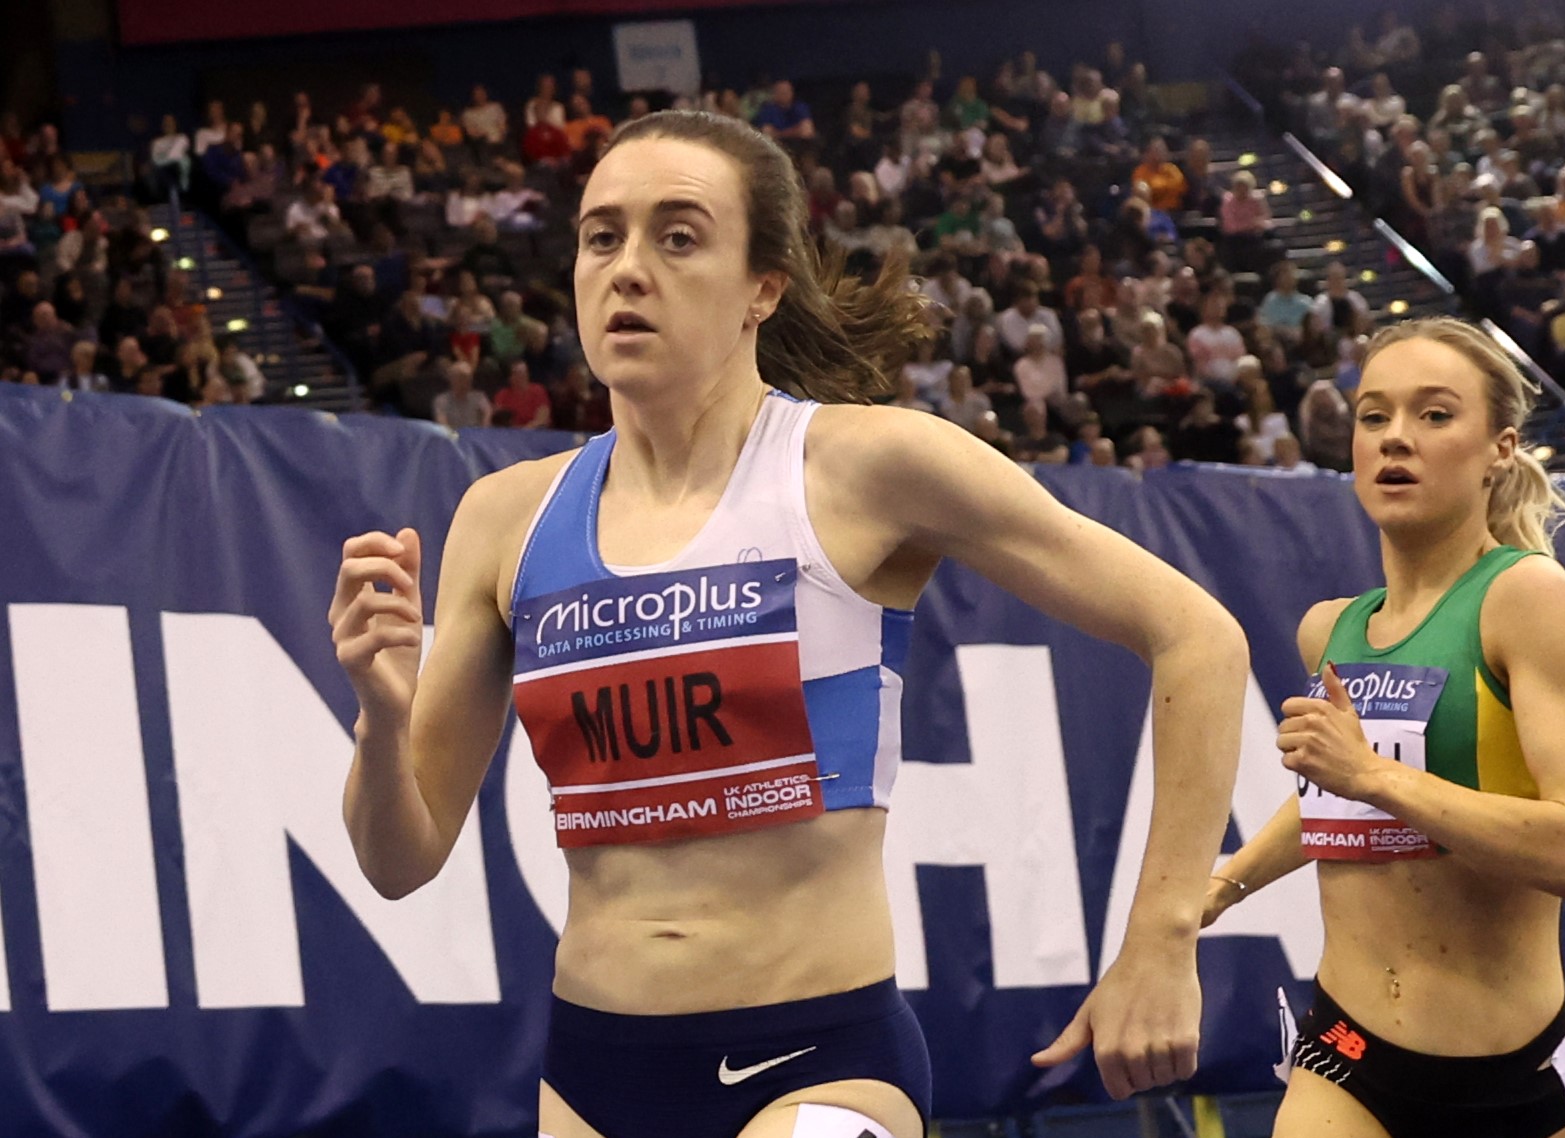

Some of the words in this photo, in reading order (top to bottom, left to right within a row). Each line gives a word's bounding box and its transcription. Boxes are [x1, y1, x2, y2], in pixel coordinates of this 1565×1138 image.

[536, 576, 762, 645] Microplus
[538, 639, 571, 658] DATA
[576, 623, 671, 650] PROCESSING
[682, 620, 693, 633] &
[697, 611, 757, 630] TIMING
[571, 672, 734, 763] MUIR
[1375, 701, 1409, 712] TIMING
[723, 785, 741, 796] UK
[743, 773, 810, 793] ATHLETICS
[725, 783, 812, 811] INDOOR
[557, 797, 718, 831] BIRMINGHAM
[727, 798, 814, 820] CHAMPIONSHIPS
